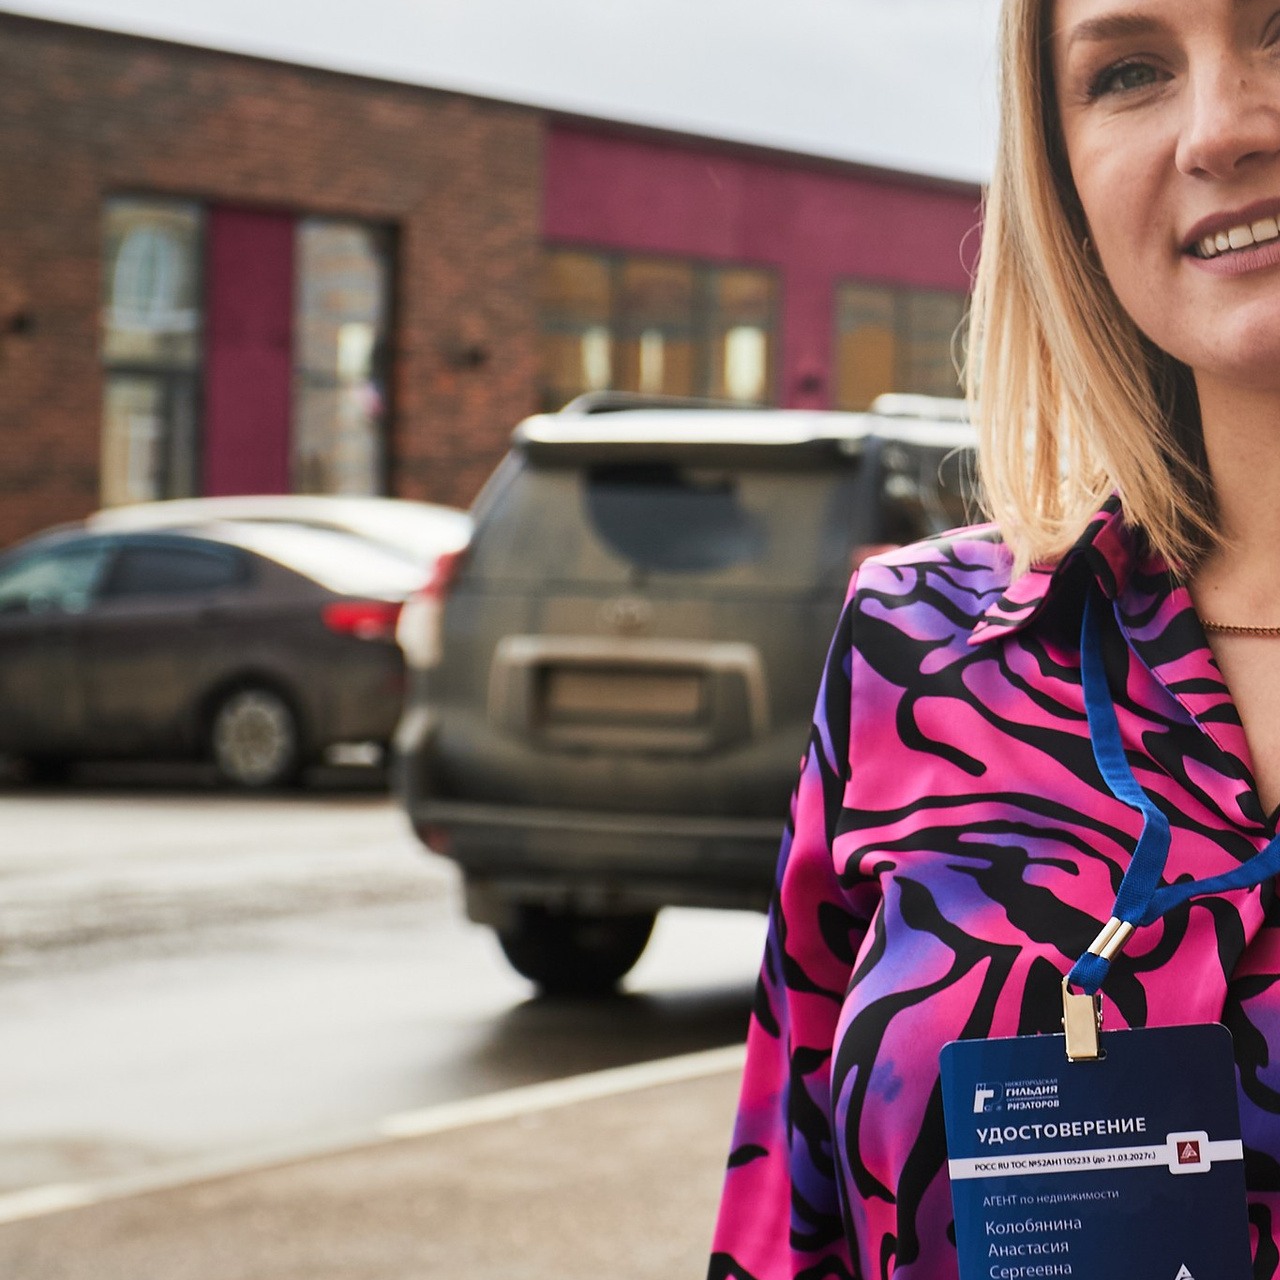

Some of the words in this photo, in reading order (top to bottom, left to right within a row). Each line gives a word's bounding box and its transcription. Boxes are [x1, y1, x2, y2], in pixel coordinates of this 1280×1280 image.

[1006, 1085, 1058, 1097] ГИЛЬДИЯ
[1007, 1099, 1060, 1111] РИЭЛТОРОВ
[976, 1117, 1147, 1145] УДОСТОВЕРЕНИЕ
[974, 1162, 997, 1171] РОСС
[998, 1161, 1010, 1170] RU
[983, 1194, 1017, 1207] АГЕНТ
[1020, 1195, 1034, 1205] по
[1036, 1190, 1119, 1204] недвижимости
[985, 1218, 1082, 1235] Колобянина
[988, 1241, 1069, 1257] Анастасия
